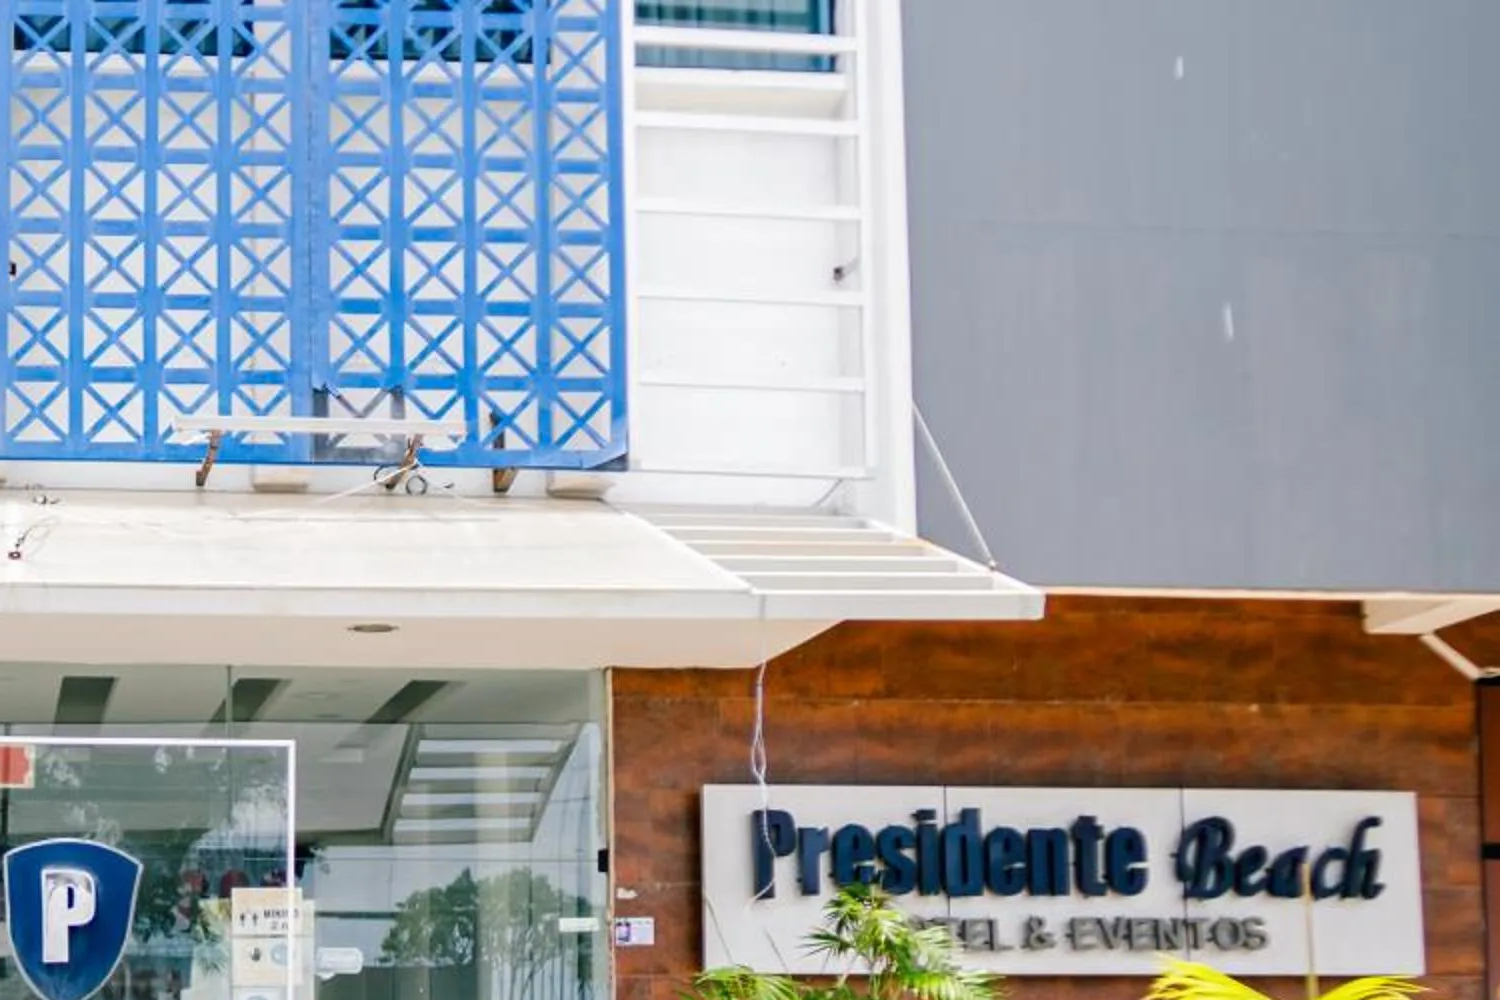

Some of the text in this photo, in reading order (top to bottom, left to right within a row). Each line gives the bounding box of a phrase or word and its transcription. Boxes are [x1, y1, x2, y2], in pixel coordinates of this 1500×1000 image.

[751, 807, 1385, 900] Presidente Beach
[41, 868, 96, 964] P
[1066, 916, 1269, 952] EVENTOS
